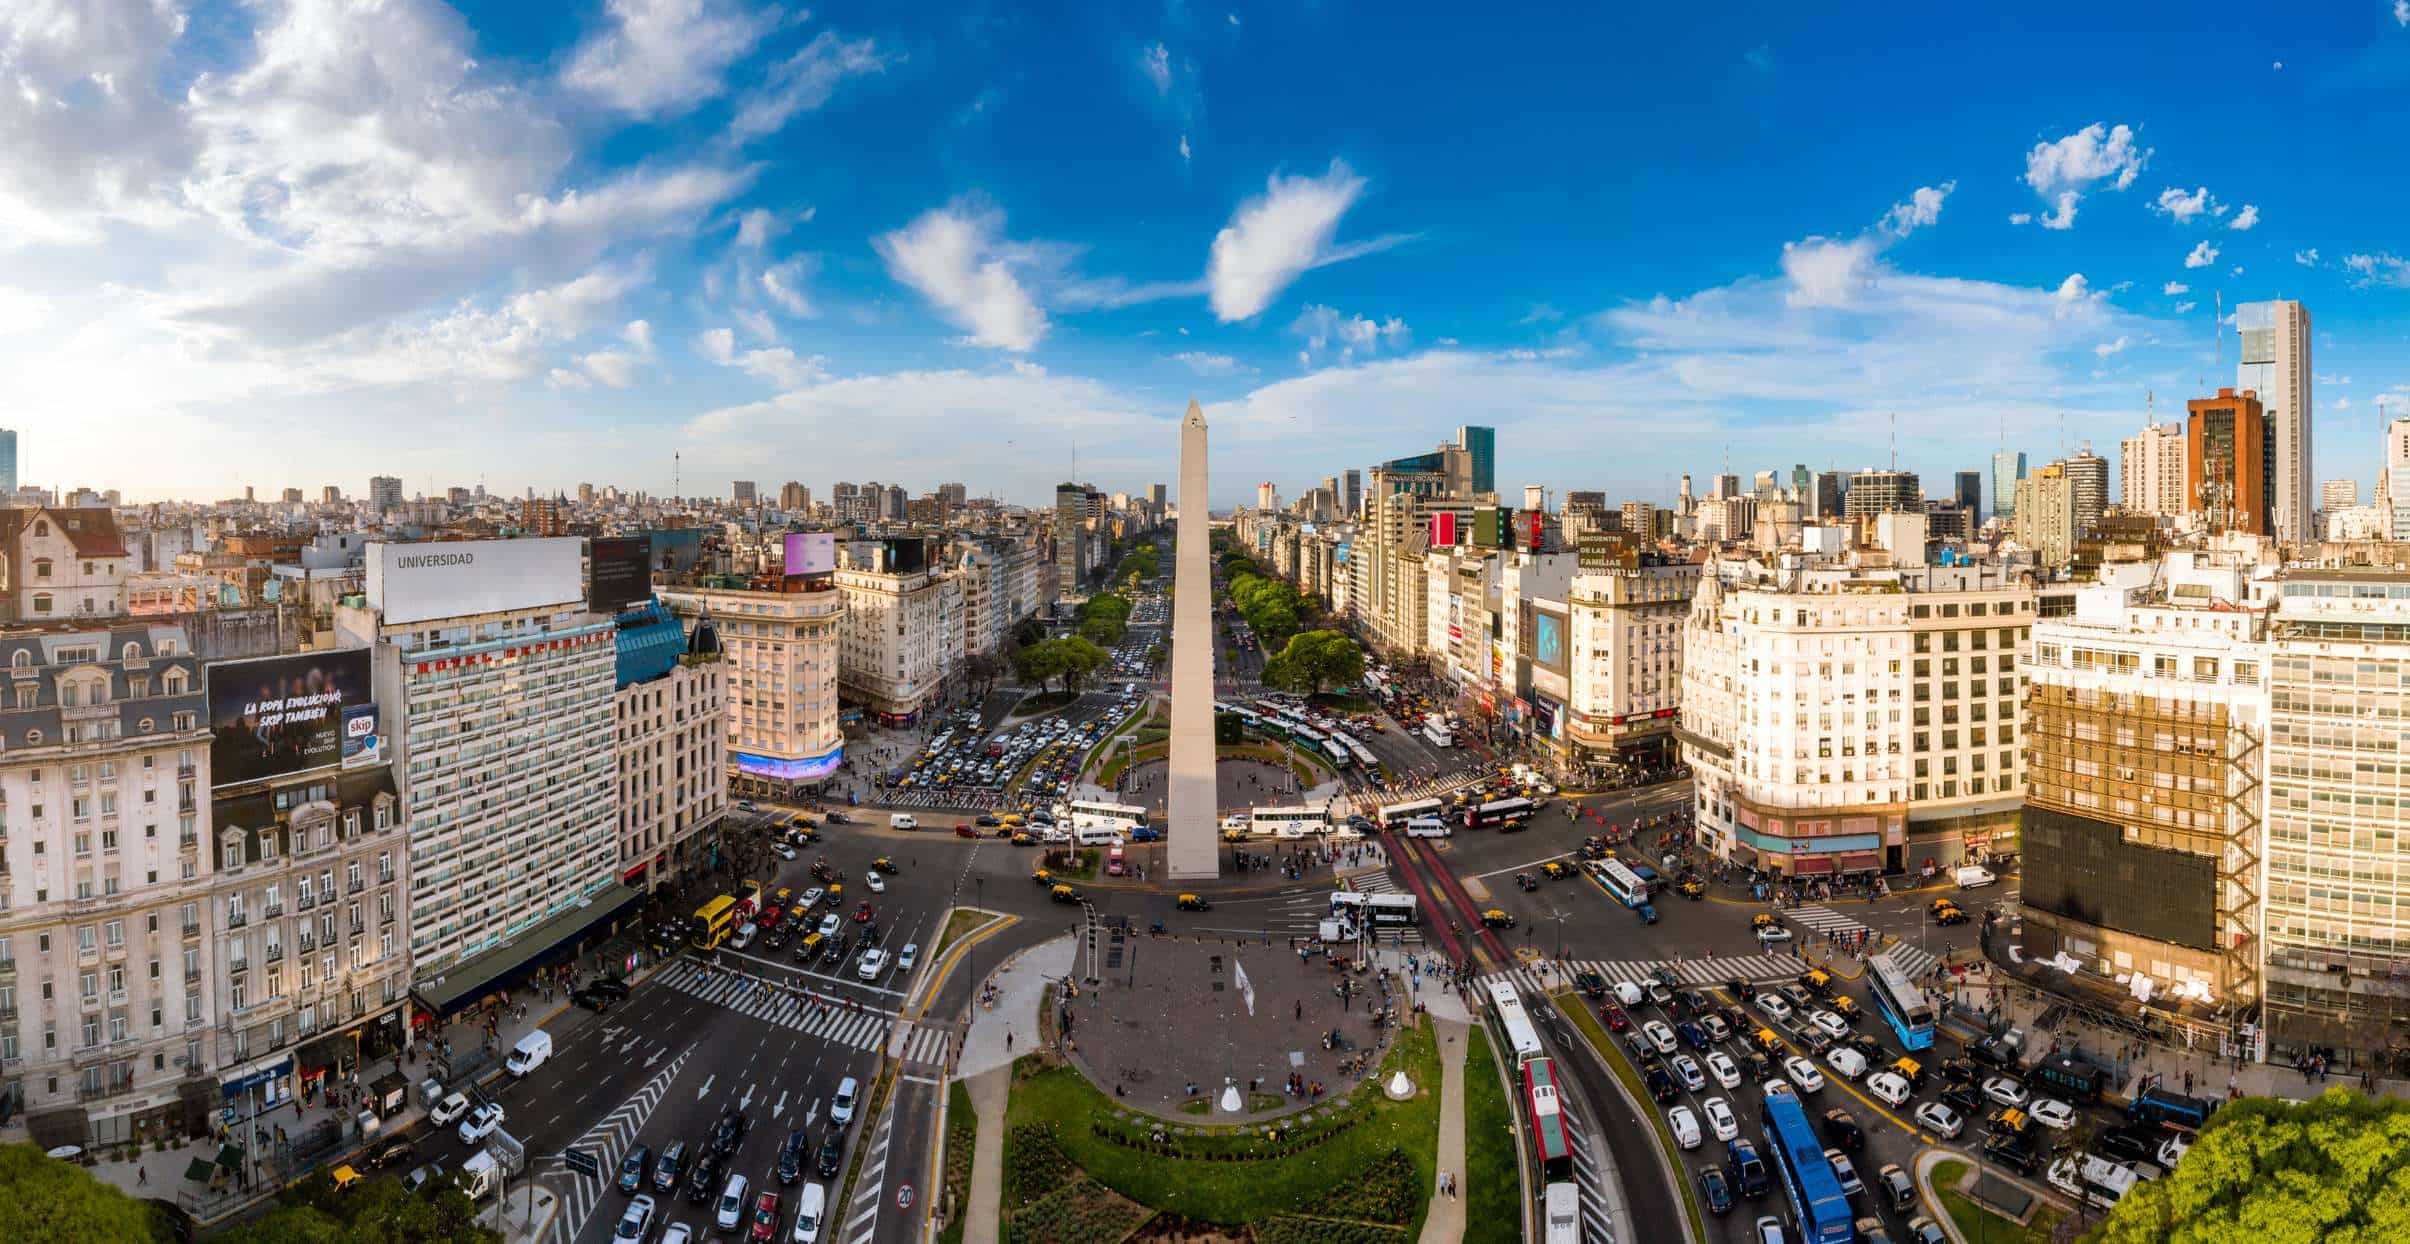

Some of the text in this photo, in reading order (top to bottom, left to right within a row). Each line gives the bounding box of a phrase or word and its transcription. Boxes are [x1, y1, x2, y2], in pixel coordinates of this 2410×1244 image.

[398, 553, 473, 569] UNIVERSIDAD
[244, 702, 257, 715] LA
[260, 699, 283, 713] ROPA
[260, 712, 283, 727] SKIP
[350, 720, 371, 733] skip
[900, 1188, 912, 1203] 20
